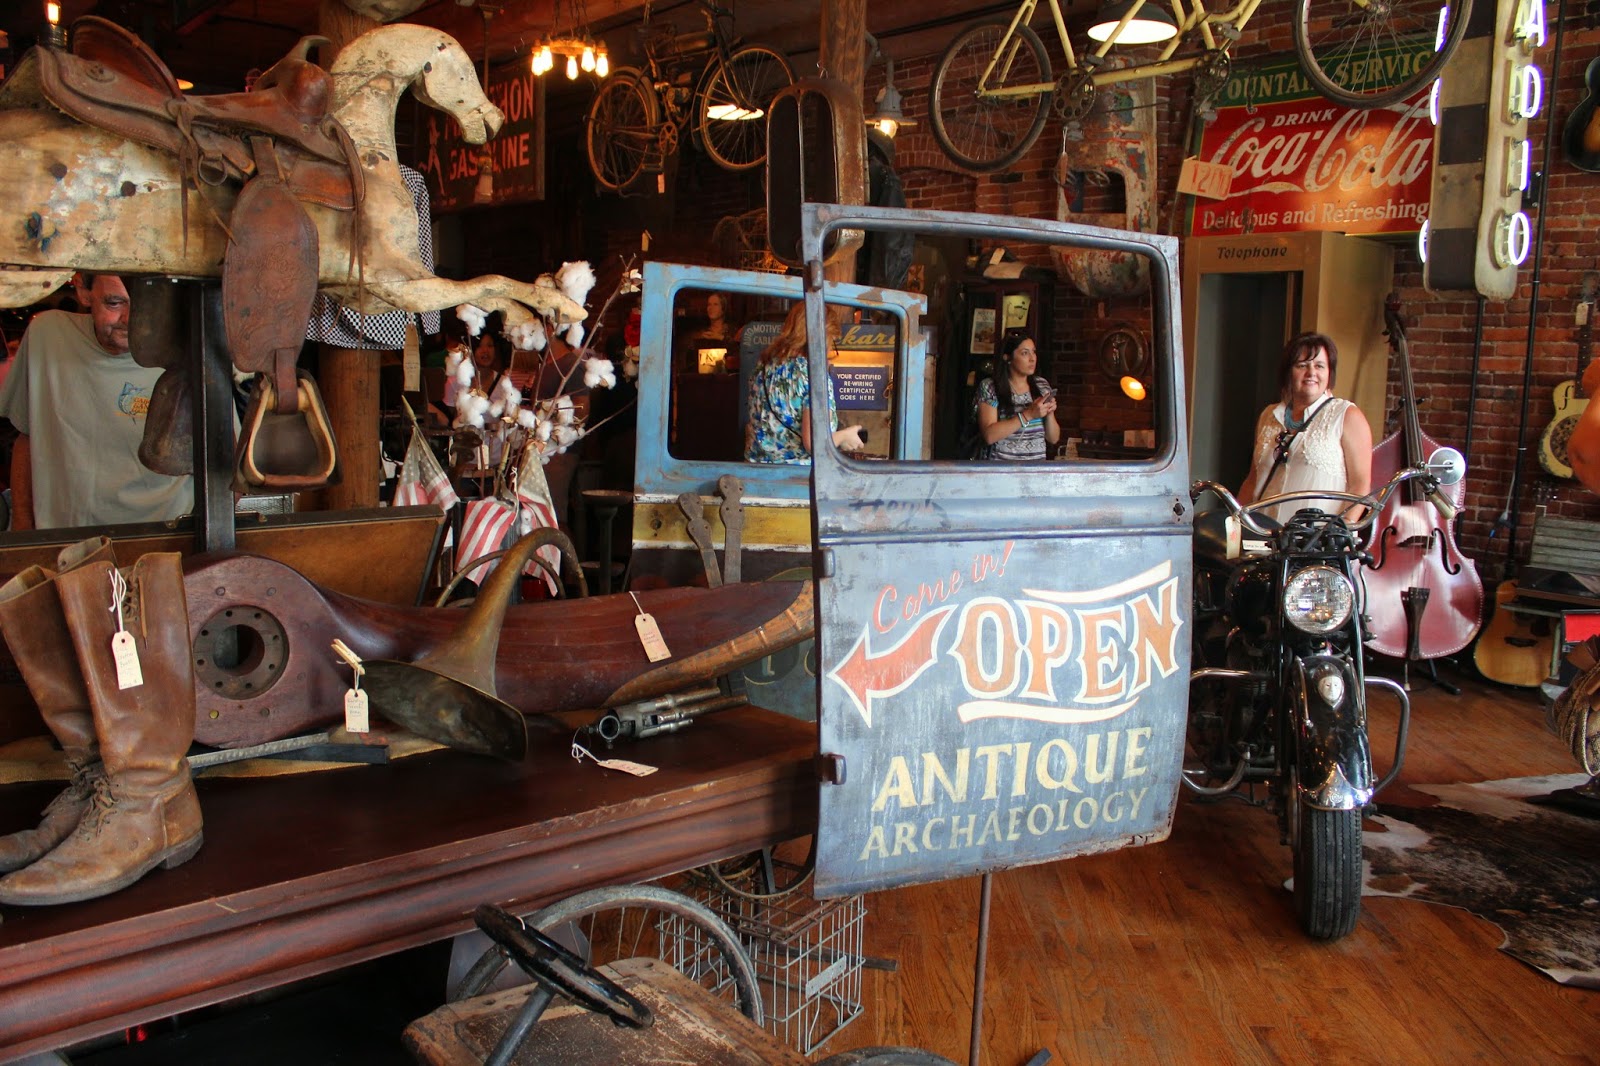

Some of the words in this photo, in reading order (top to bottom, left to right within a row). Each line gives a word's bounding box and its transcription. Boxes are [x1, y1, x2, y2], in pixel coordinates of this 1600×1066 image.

[1334, 50, 1431, 87] SERVIC
[1271, 108, 1338, 127] DRINK
[449, 132, 530, 181] GASLINE
[1202, 209, 1278, 230] Delicous
[1282, 204, 1316, 226] and
[1321, 199, 1429, 225] Refreshing
[1217, 246, 1288, 260] Telephone
[872, 572, 963, 633] Come
[971, 540, 1016, 584] in!
[946, 576, 1184, 704] OPEN
[870, 726, 1152, 813] ANTIQUE
[857, 786, 1149, 862] ARCHAEOLOGY
